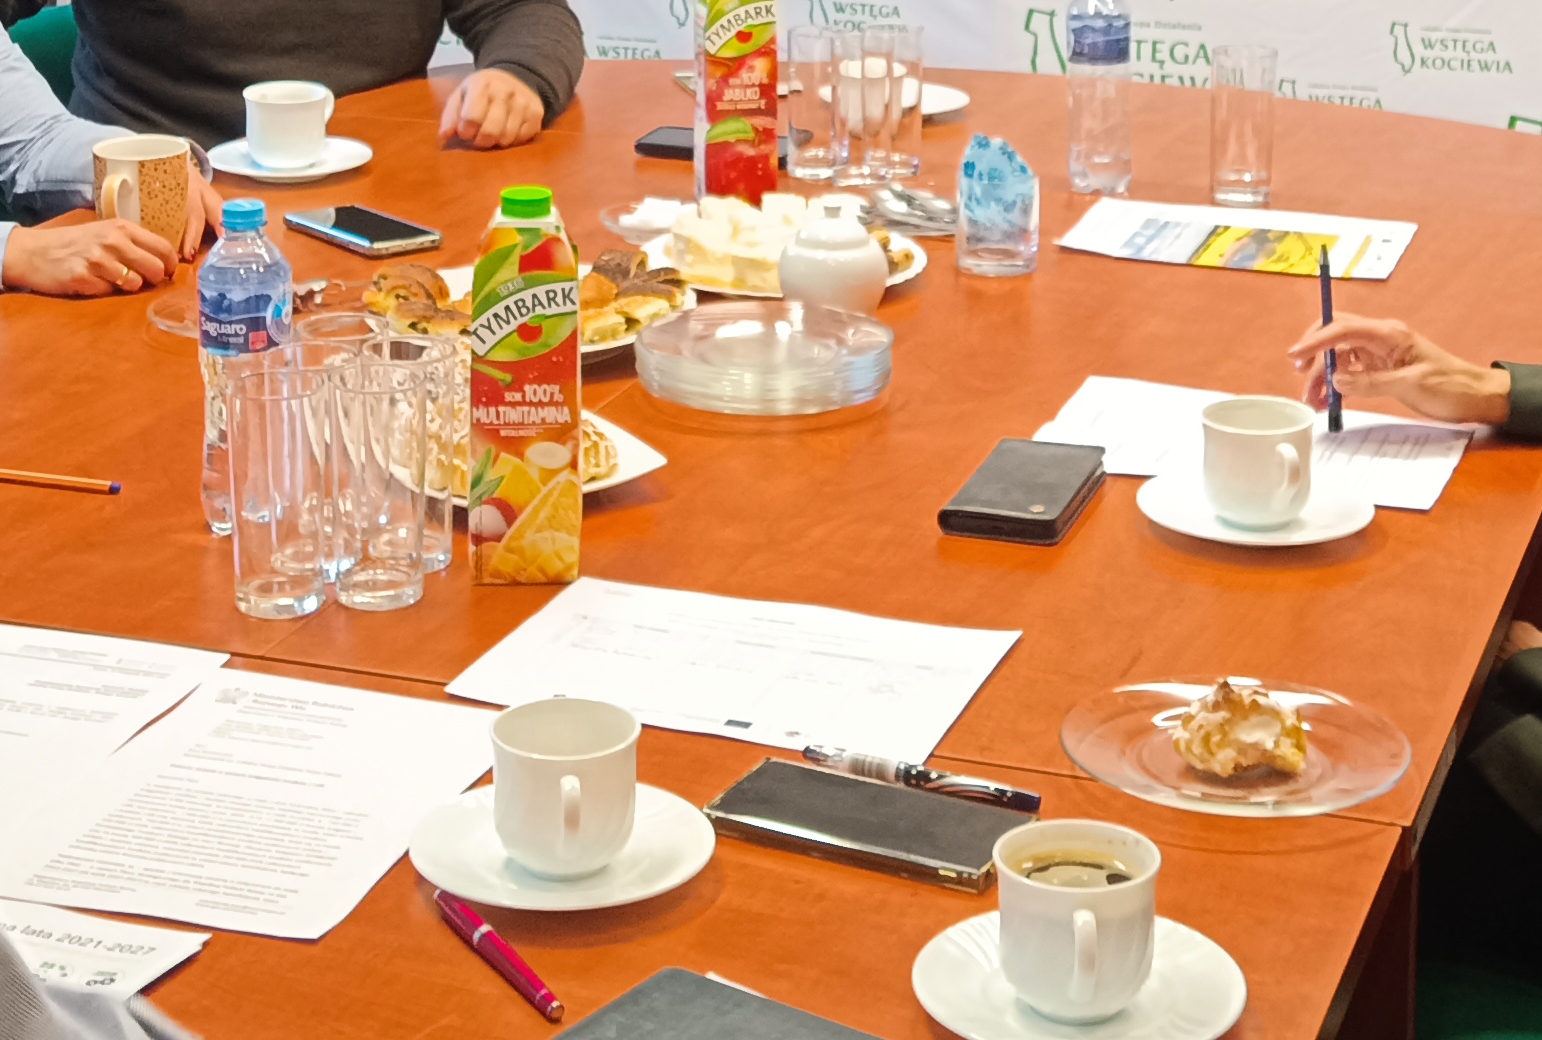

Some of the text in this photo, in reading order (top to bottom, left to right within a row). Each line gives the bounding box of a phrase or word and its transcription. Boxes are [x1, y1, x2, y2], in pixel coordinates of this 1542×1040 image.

[832, 1, 900, 20] WSTĘGA
[706, 4, 775, 47] TYMBARK
[1133, 40, 1212, 68] TĘGA
[1421, 37, 1496, 57] WSTĘGA
[1420, 56, 1513, 74] KOCIEWIA
[471, 286, 577, 345] TYMBARK
[201, 317, 246, 336] Saguaro
[524, 384, 564, 402] 100%
[20, 925, 53, 940] lata
[55, 933, 157, 956] 2021-2027
